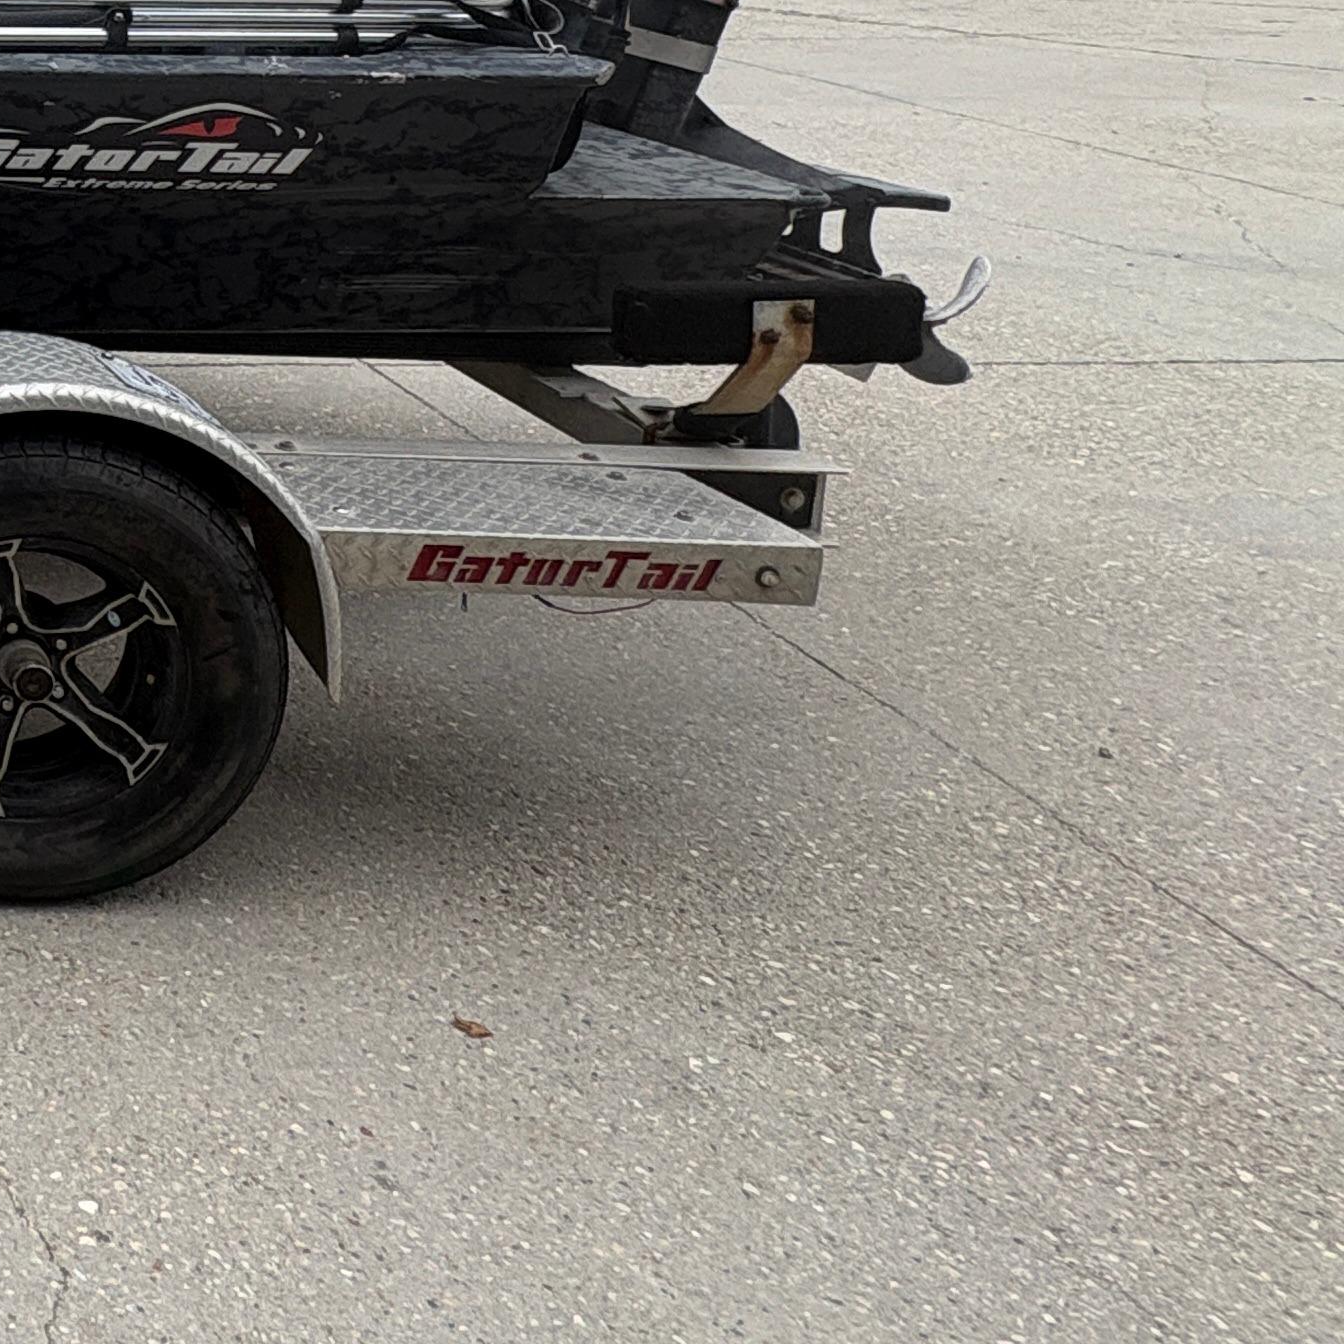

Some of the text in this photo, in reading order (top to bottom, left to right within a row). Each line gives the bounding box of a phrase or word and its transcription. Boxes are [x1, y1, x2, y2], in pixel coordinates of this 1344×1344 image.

[43, 177, 279, 191] Extreme Series
[407, 544, 723, 591] GatorTail
